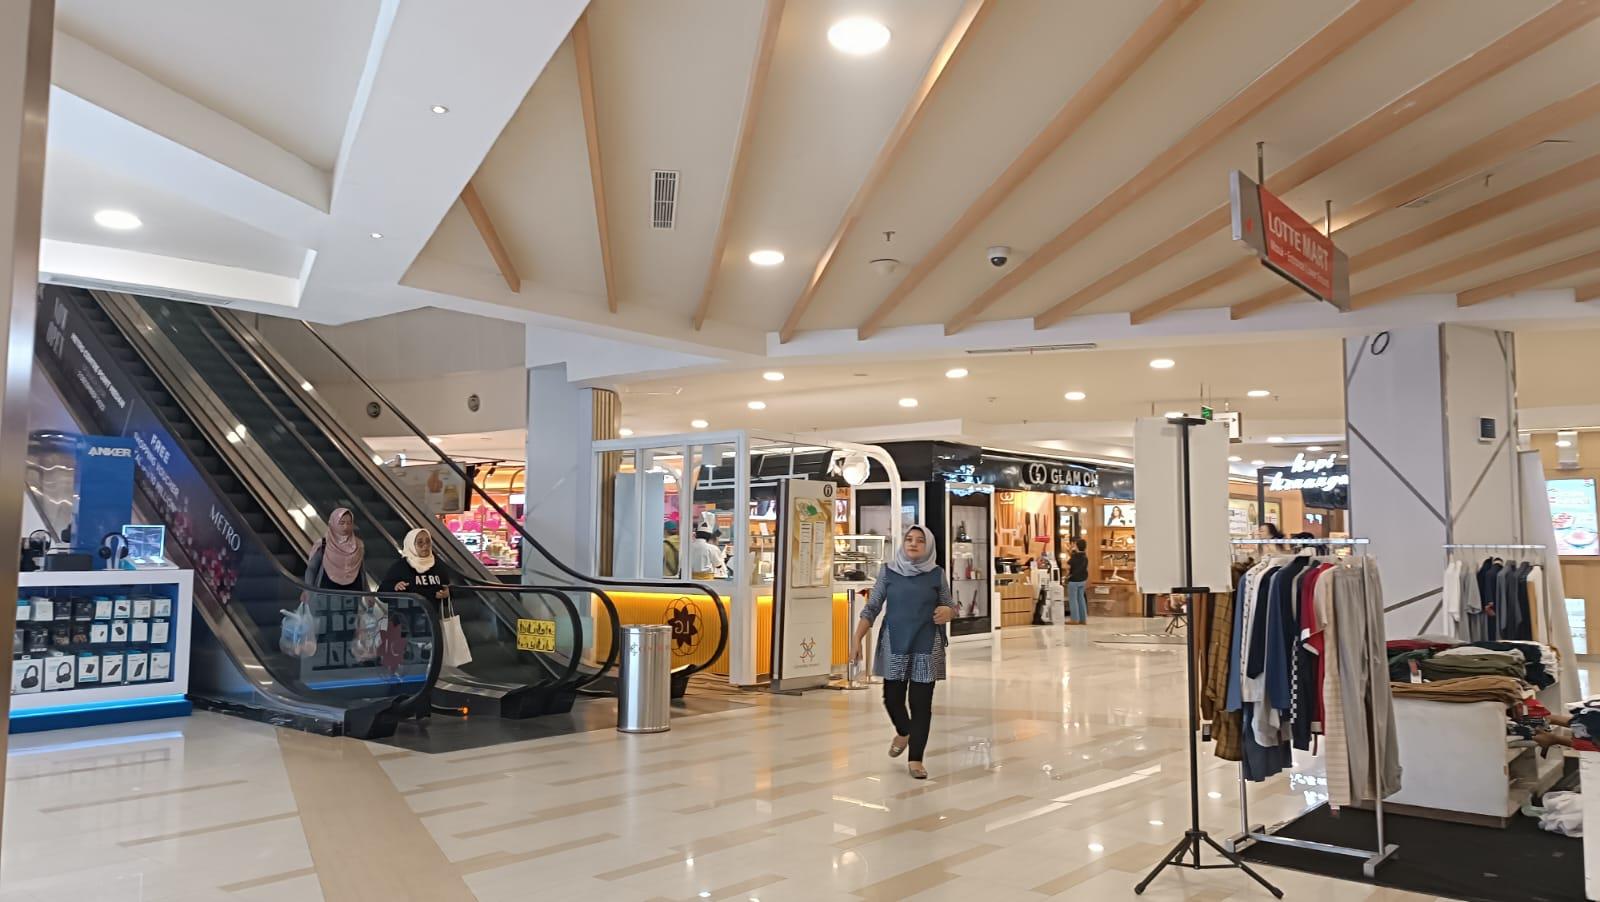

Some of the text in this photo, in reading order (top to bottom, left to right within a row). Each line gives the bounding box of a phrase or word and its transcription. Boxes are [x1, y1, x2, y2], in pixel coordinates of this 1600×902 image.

[1267, 211, 1301, 252] LOTTE
[1302, 234, 1329, 271] MART
[88, 446, 132, 458] ANKER
[150, 434, 171, 464] FREE
[1051, 468, 1081, 486] GLAM
[208, 503, 241, 551] METRO
[415, 575, 441, 586] AERO
